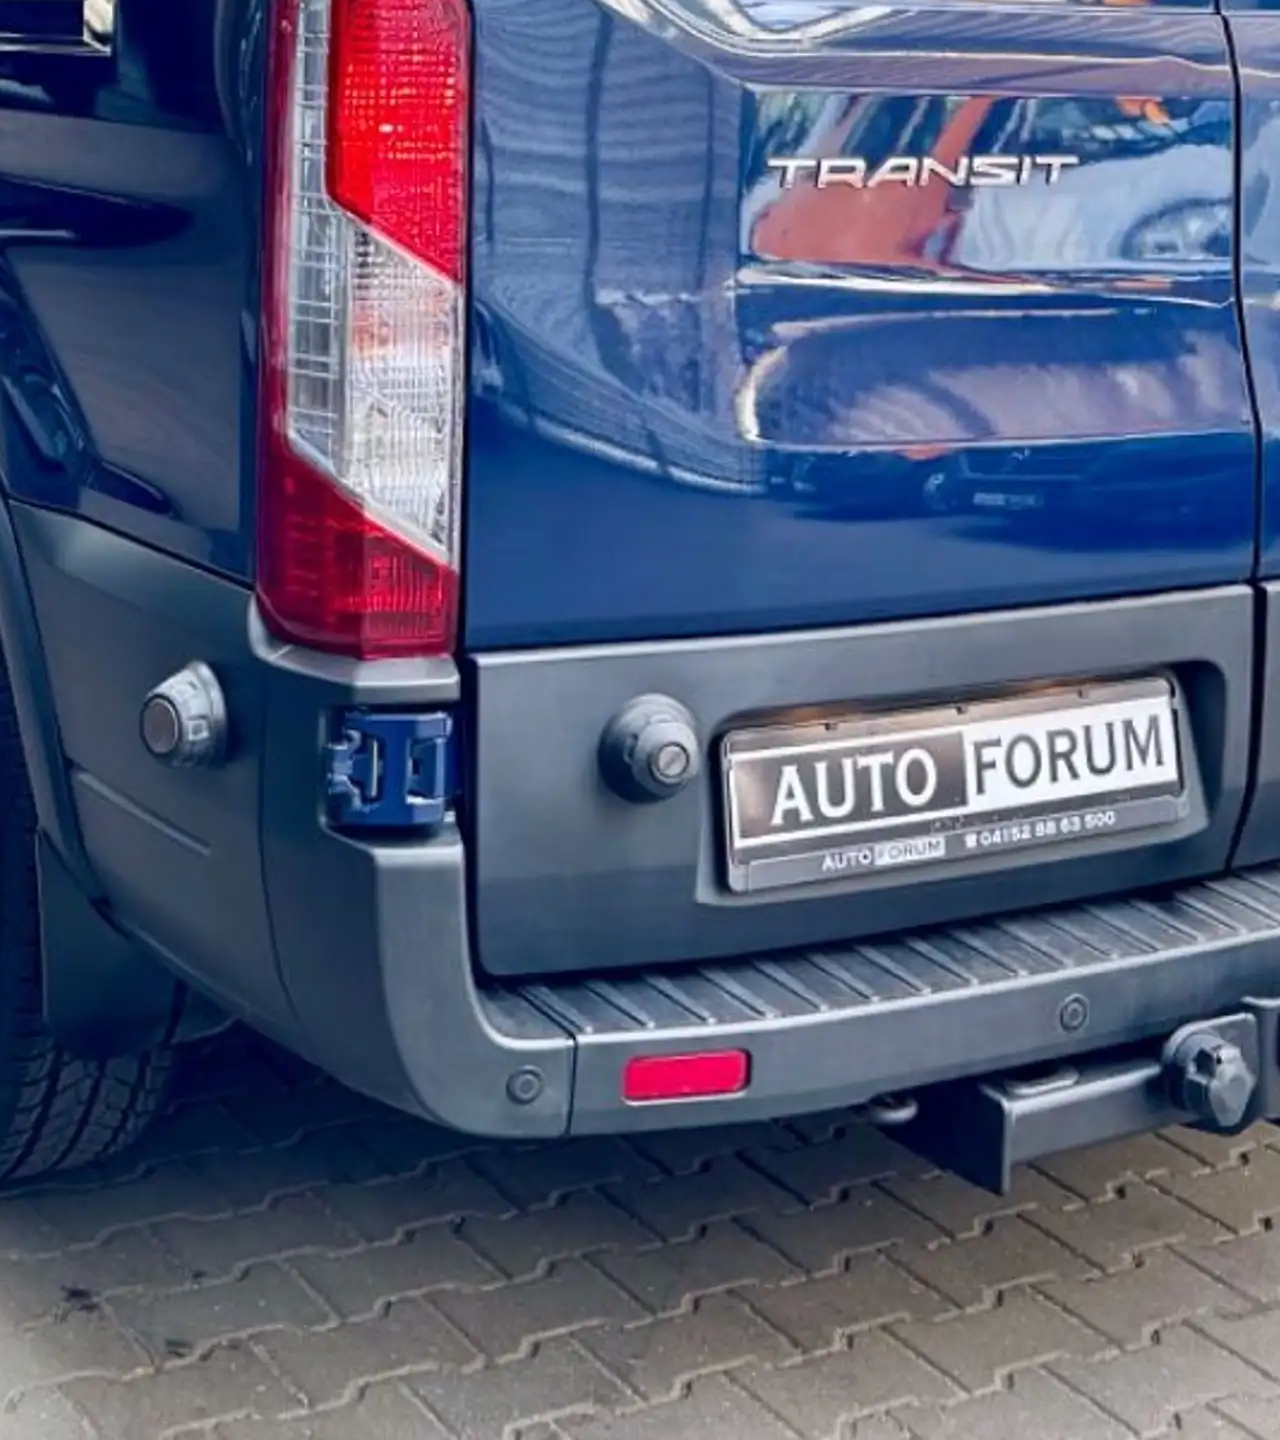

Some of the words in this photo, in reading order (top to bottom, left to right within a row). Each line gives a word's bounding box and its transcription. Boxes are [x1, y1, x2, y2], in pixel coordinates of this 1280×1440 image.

[767, 154, 1079, 190] TRANSIT
[770, 746, 939, 828] AUTO
[973, 713, 1166, 796] FORUM
[822, 848, 872, 872] AUTO
[877, 839, 942, 863] FORUM
[979, 824, 1032, 847] 04152
